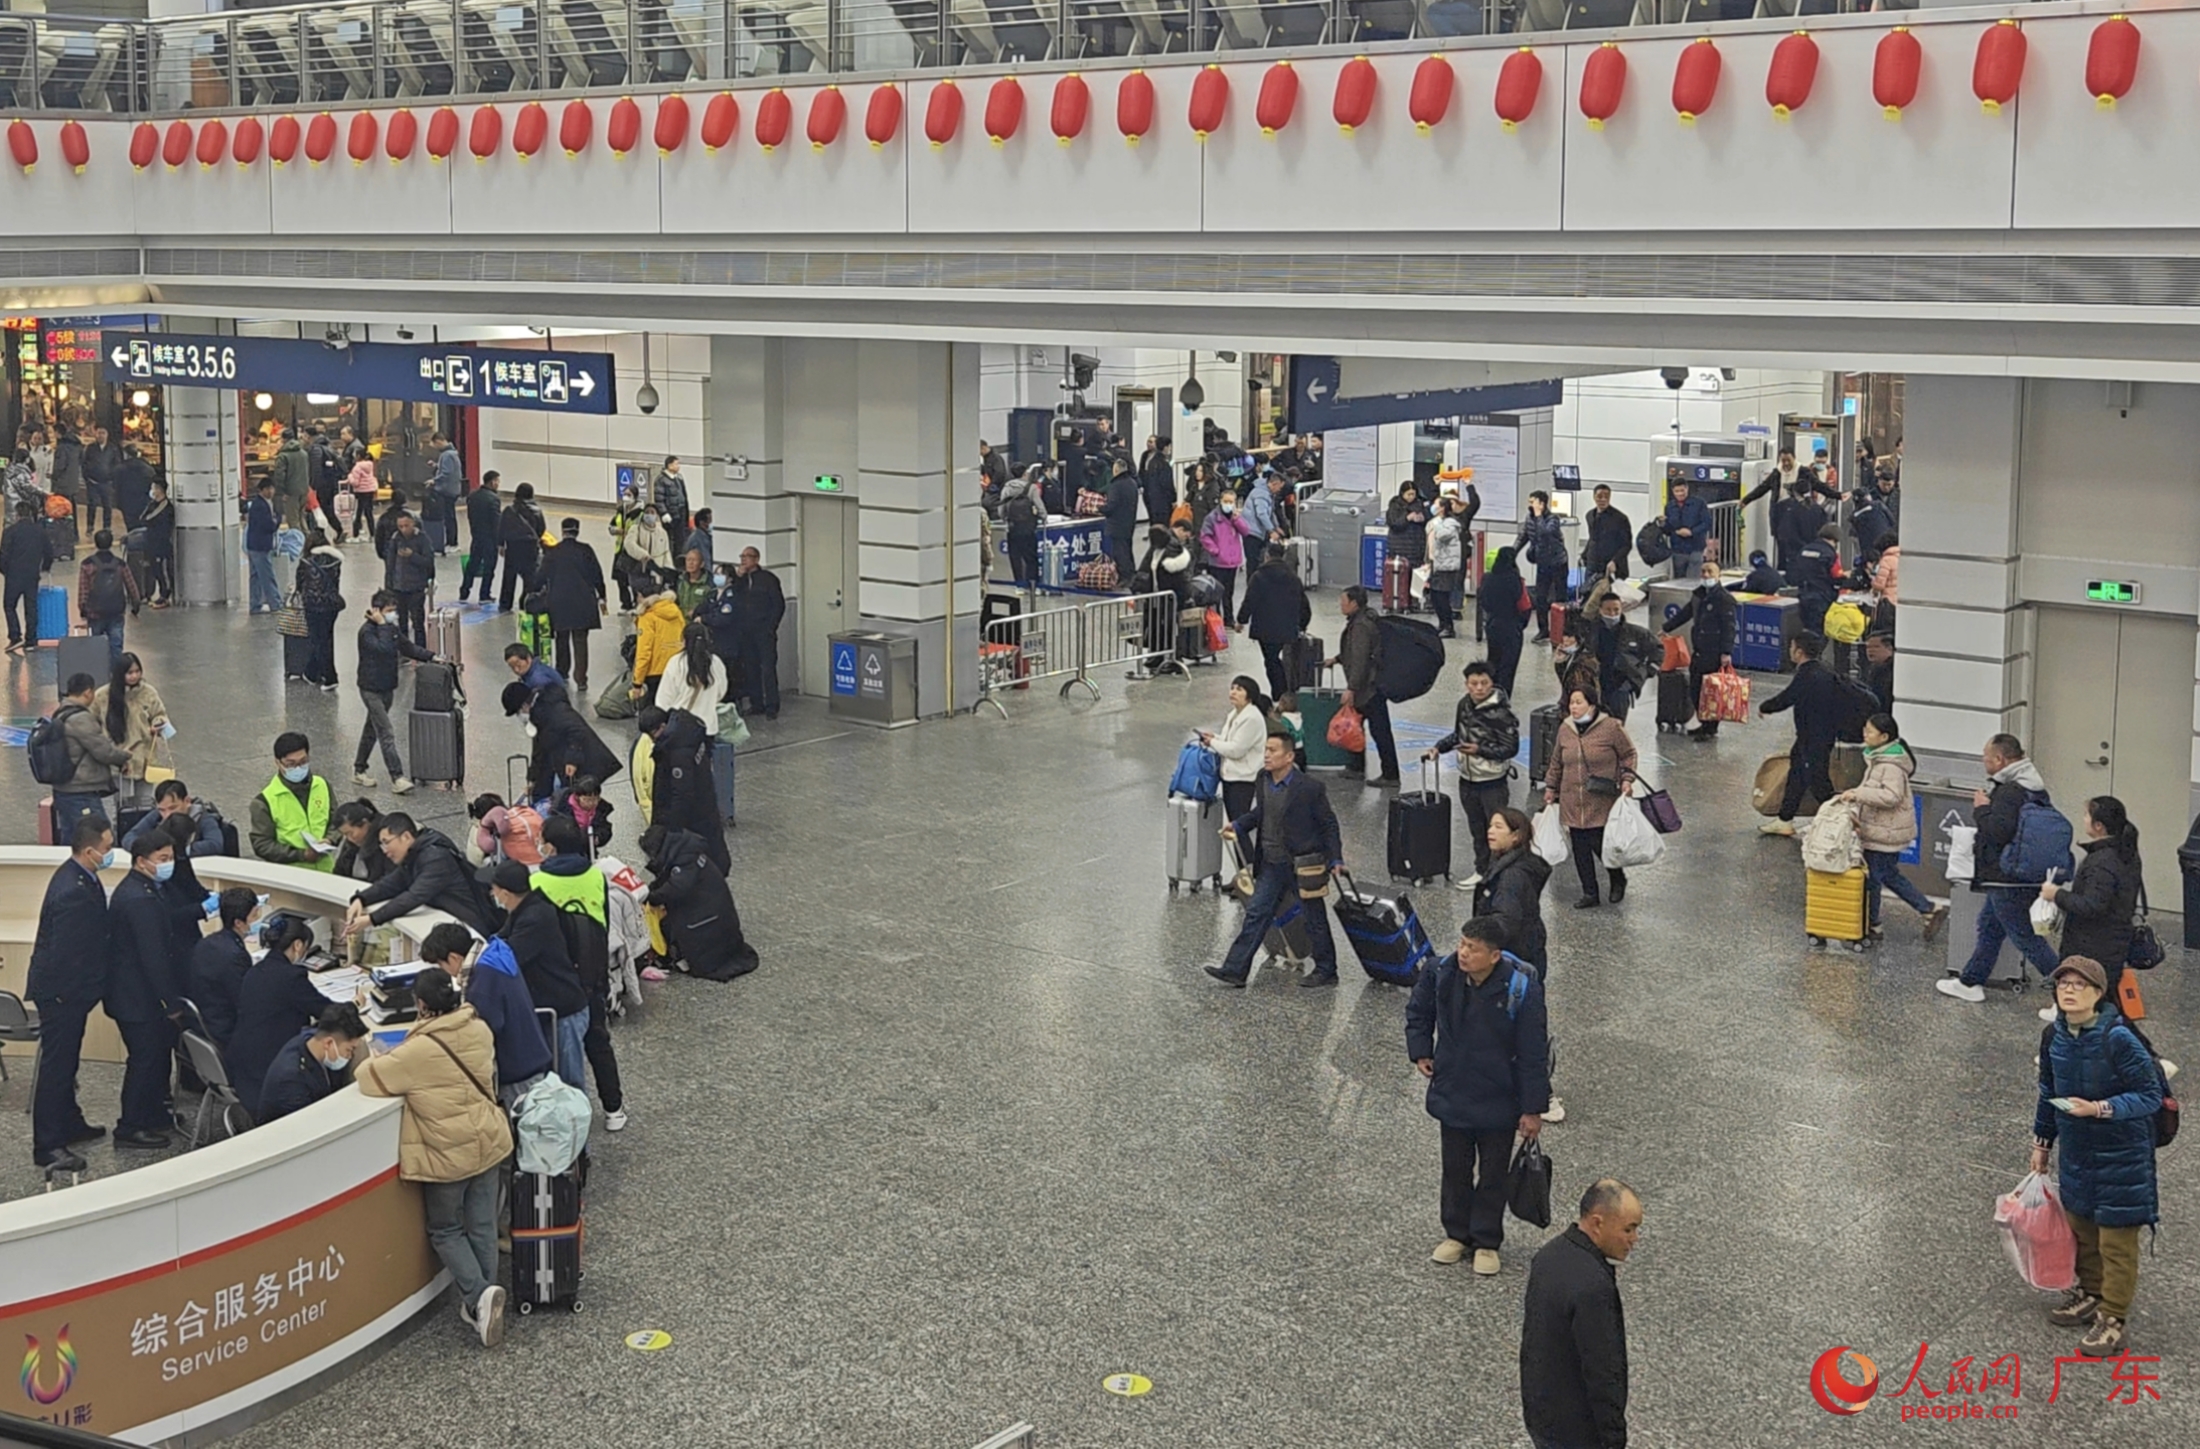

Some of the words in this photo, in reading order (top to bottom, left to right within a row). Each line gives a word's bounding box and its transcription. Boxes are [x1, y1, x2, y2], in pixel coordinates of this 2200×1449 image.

[152, 344, 185, 364] 候车室
[187, 345, 236, 379] 3.5.6
[420, 357, 445, 378] 出口
[479, 359, 491, 396] 1
[494, 361, 537, 384] 候车室
[1698, 467, 1707, 479] 3
[130, 1244, 346, 1357] 综合服务中心
[161, 1334, 249, 1382] Service
[260, 1299, 328, 1343] Center
